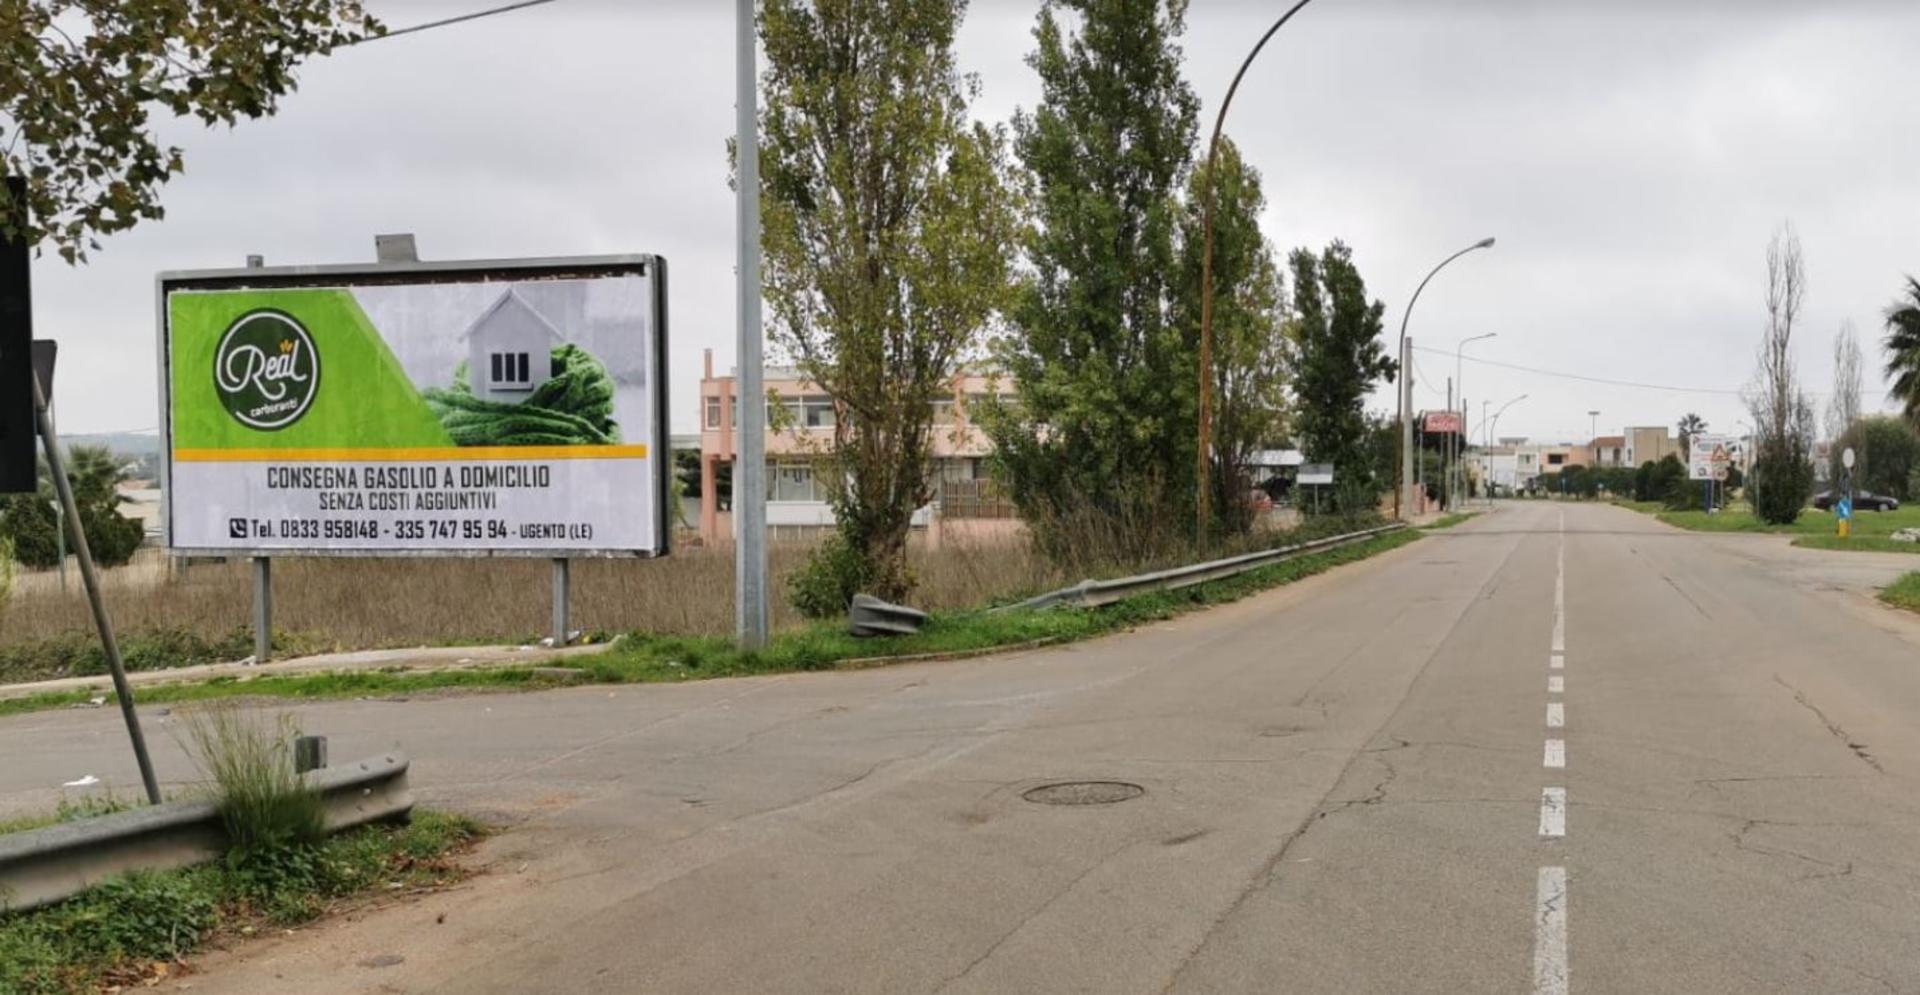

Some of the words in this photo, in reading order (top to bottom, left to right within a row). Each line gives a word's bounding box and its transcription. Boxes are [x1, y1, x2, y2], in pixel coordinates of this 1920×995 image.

[219, 339, 308, 401] Real
[250, 398, 299, 417] carburanti
[267, 466, 358, 489] CONSEGNA
[364, 466, 437, 489] GASOLIO
[443, 466, 455, 488] A
[460, 465, 550, 488] DOMICILIO
[319, 491, 364, 510] SENZA
[368, 491, 410, 510] COSTI
[415, 491, 497, 511] AGGIUNTIVI
[251, 519, 276, 538] Tel.
[280, 519, 319, 539] 0833
[324, 520, 378, 539] 958148
[395, 520, 425, 539] 335
[429, 520, 458, 539] 747
[463, 520, 482, 539] 95
[487, 519, 508, 539] 94
[520, 523, 565, 539] UGENTO
[569, 523, 593, 541] (LE)
